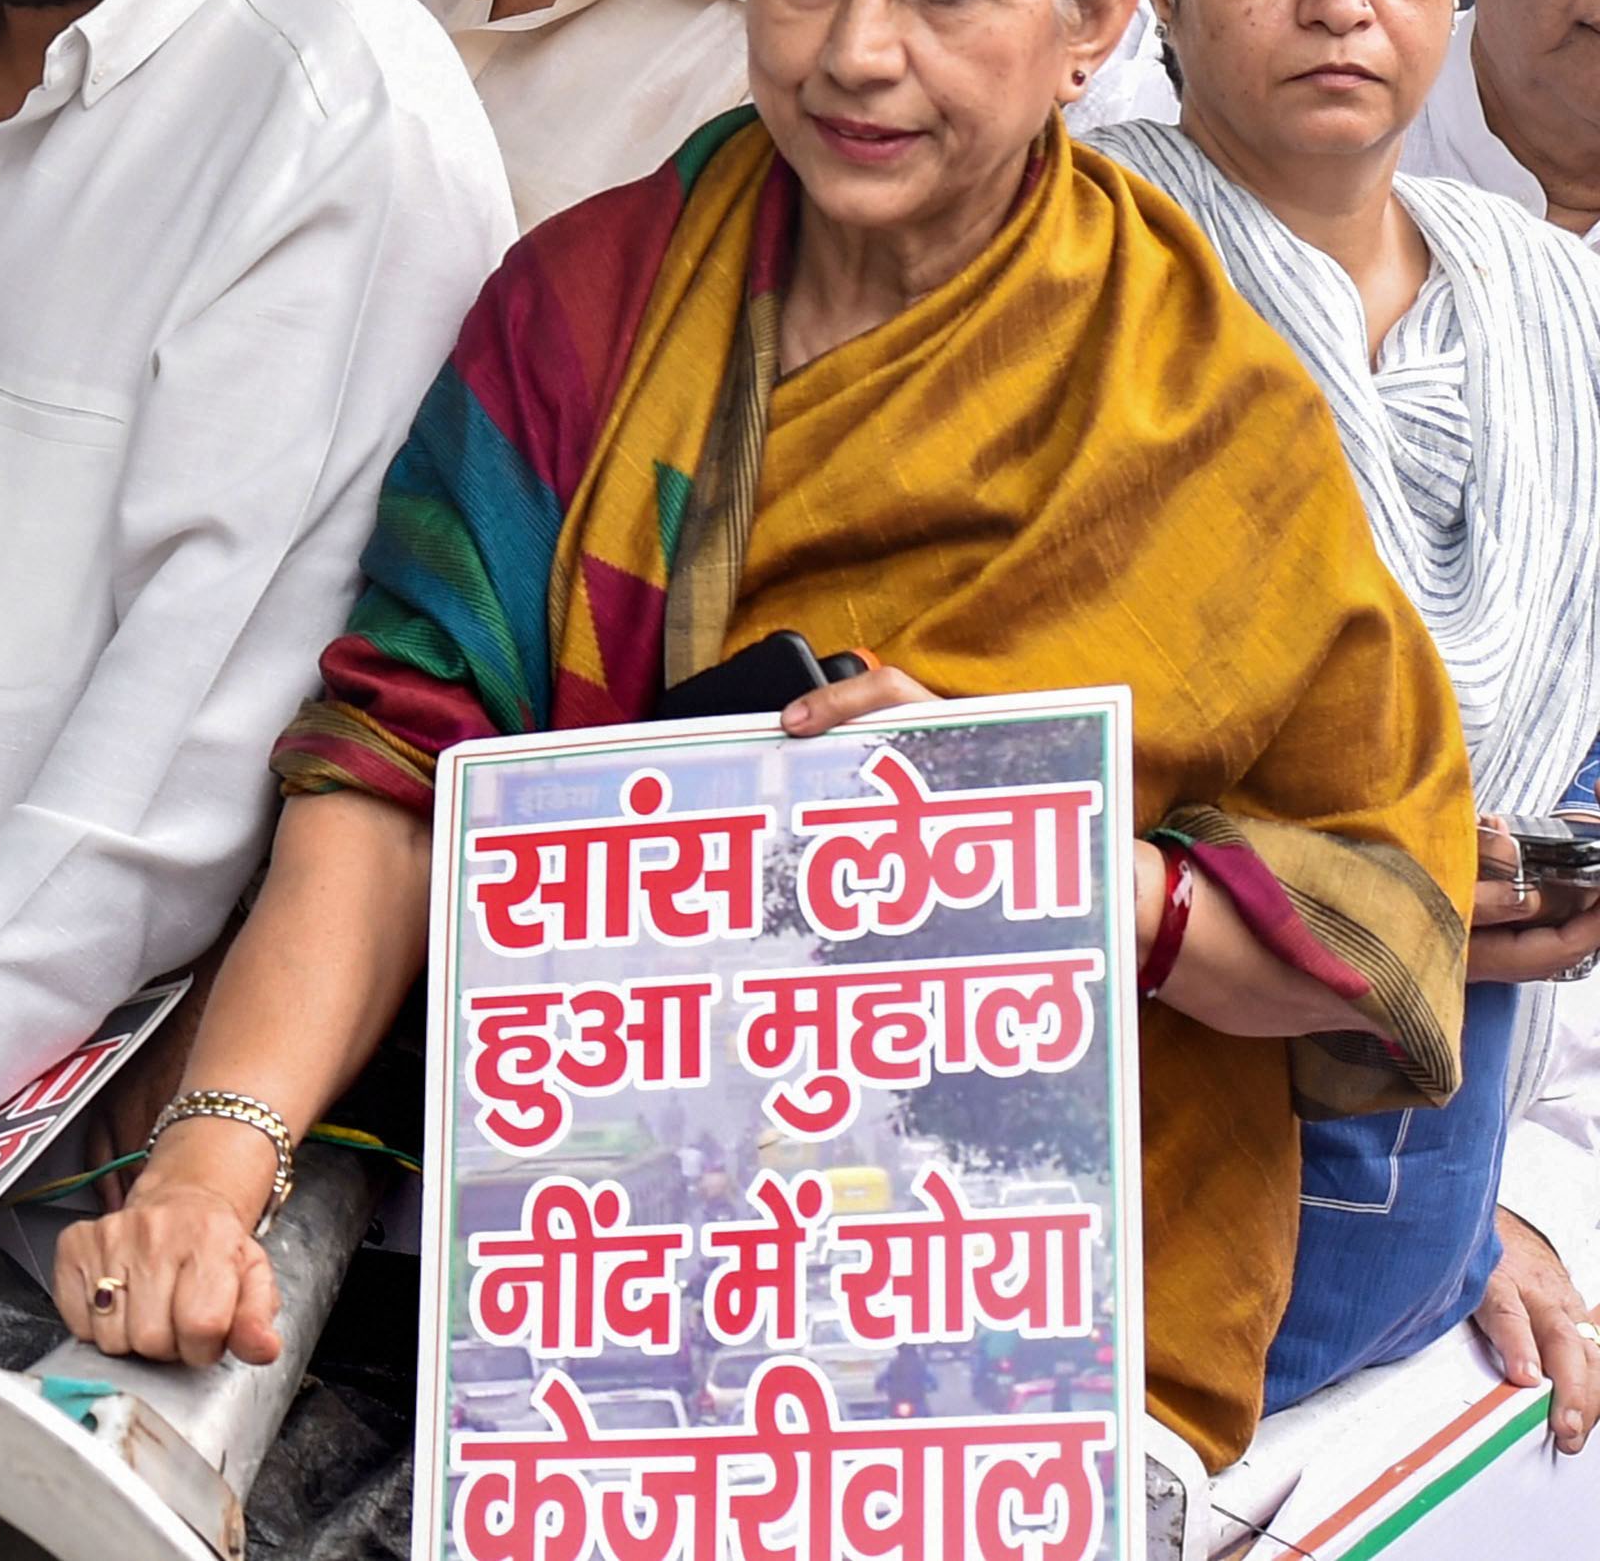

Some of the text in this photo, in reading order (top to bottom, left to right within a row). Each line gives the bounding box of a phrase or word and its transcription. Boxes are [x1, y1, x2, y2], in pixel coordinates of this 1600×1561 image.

[474, 754, 1094, 949] सांस लेना
[470, 958, 1096, 1148] हुआ मुहाल
[478, 1169, 1092, 1349] नींद में सोया
[460, 1364, 1108, 1561] केजरीवाल
